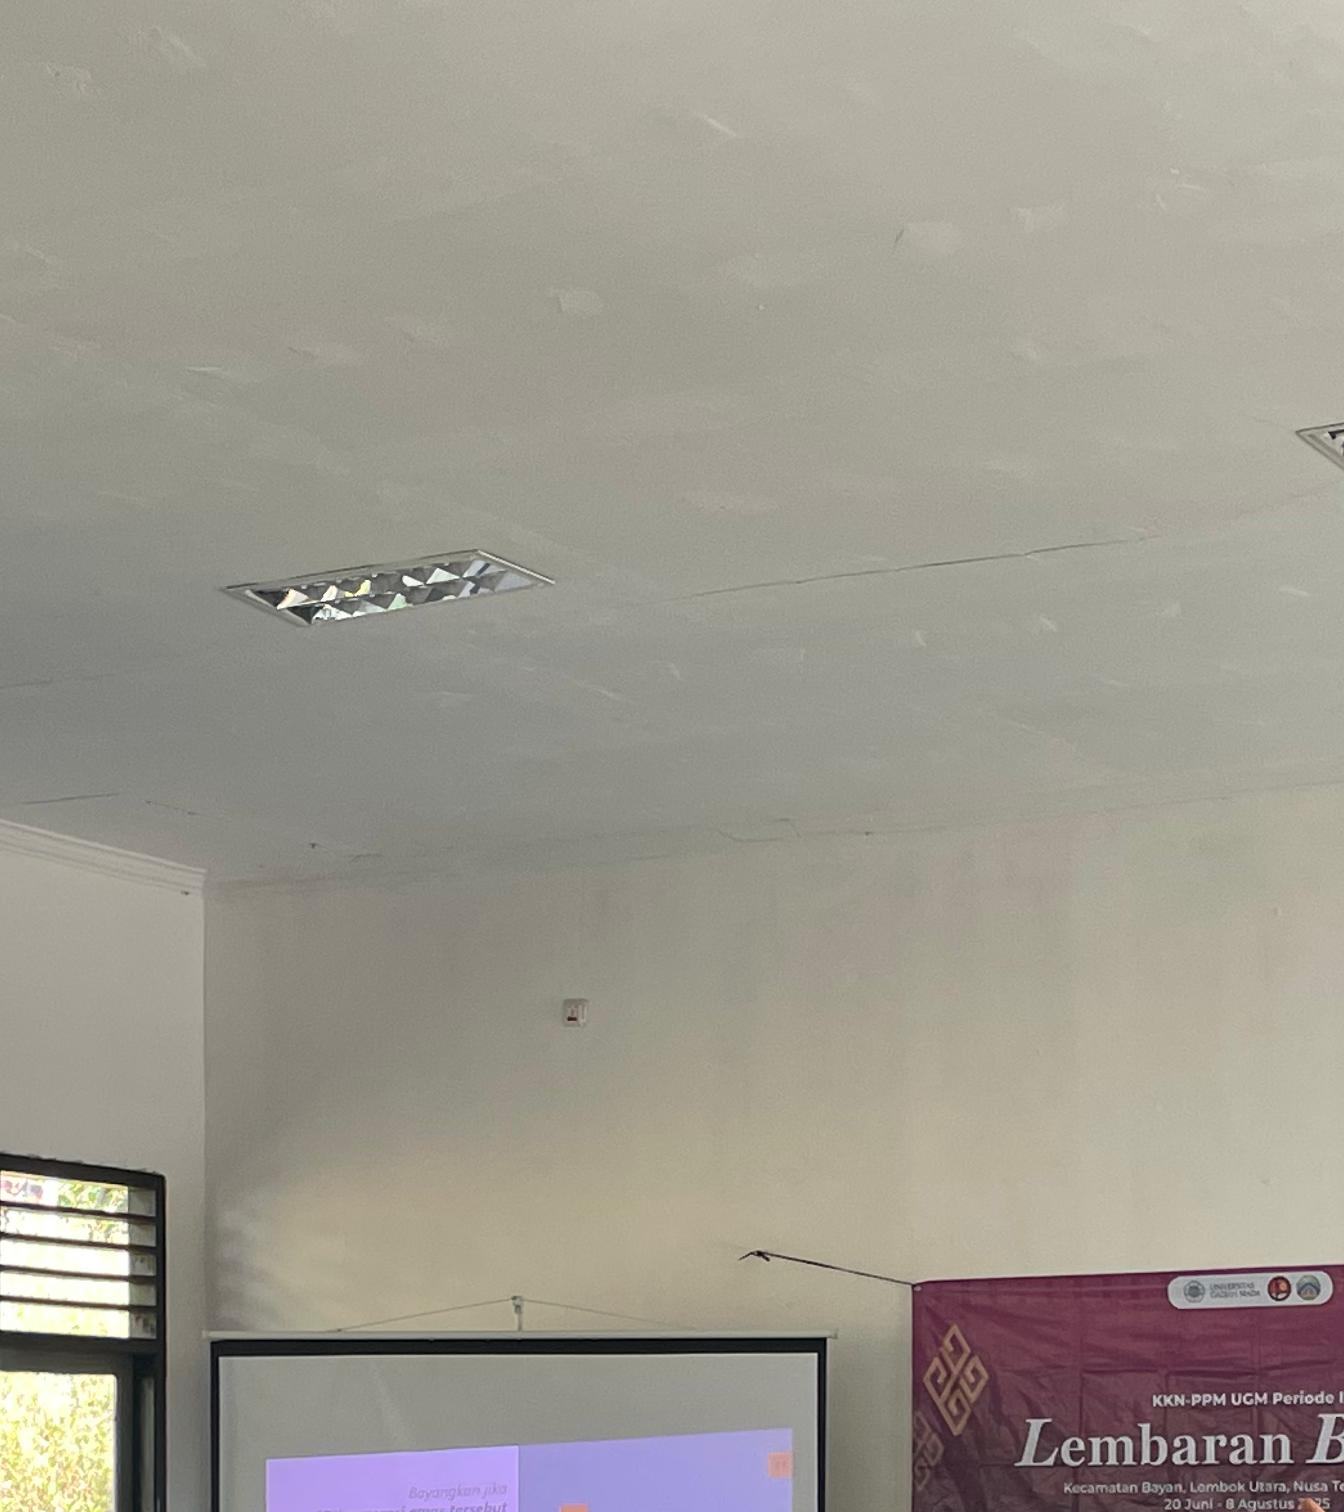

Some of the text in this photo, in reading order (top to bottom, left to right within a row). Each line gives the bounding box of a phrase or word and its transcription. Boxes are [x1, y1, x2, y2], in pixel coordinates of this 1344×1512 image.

[1152, 1392, 1227, 1407] KKN-PPM
[1230, 1391, 1268, 1406] UGM
[1272, 1390, 1335, 1405] Periode
[1014, 1417, 1294, 1467] Lembaran
[1063, 1482, 1138, 1494] Kecamatan
[1141, 1481, 1186, 1495] Bayan,
[1189, 1480, 1245, 1493] Lombok
[1249, 1480, 1290, 1494] Utara,
[1293, 1480, 1328, 1493] Nusa
[1164, 1498, 1182, 1510] 20
[1184, 1498, 1213, 1510] Juni
[1225, 1498, 1235, 1510] 8
[1237, 1498, 1295, 1512] Agustus
